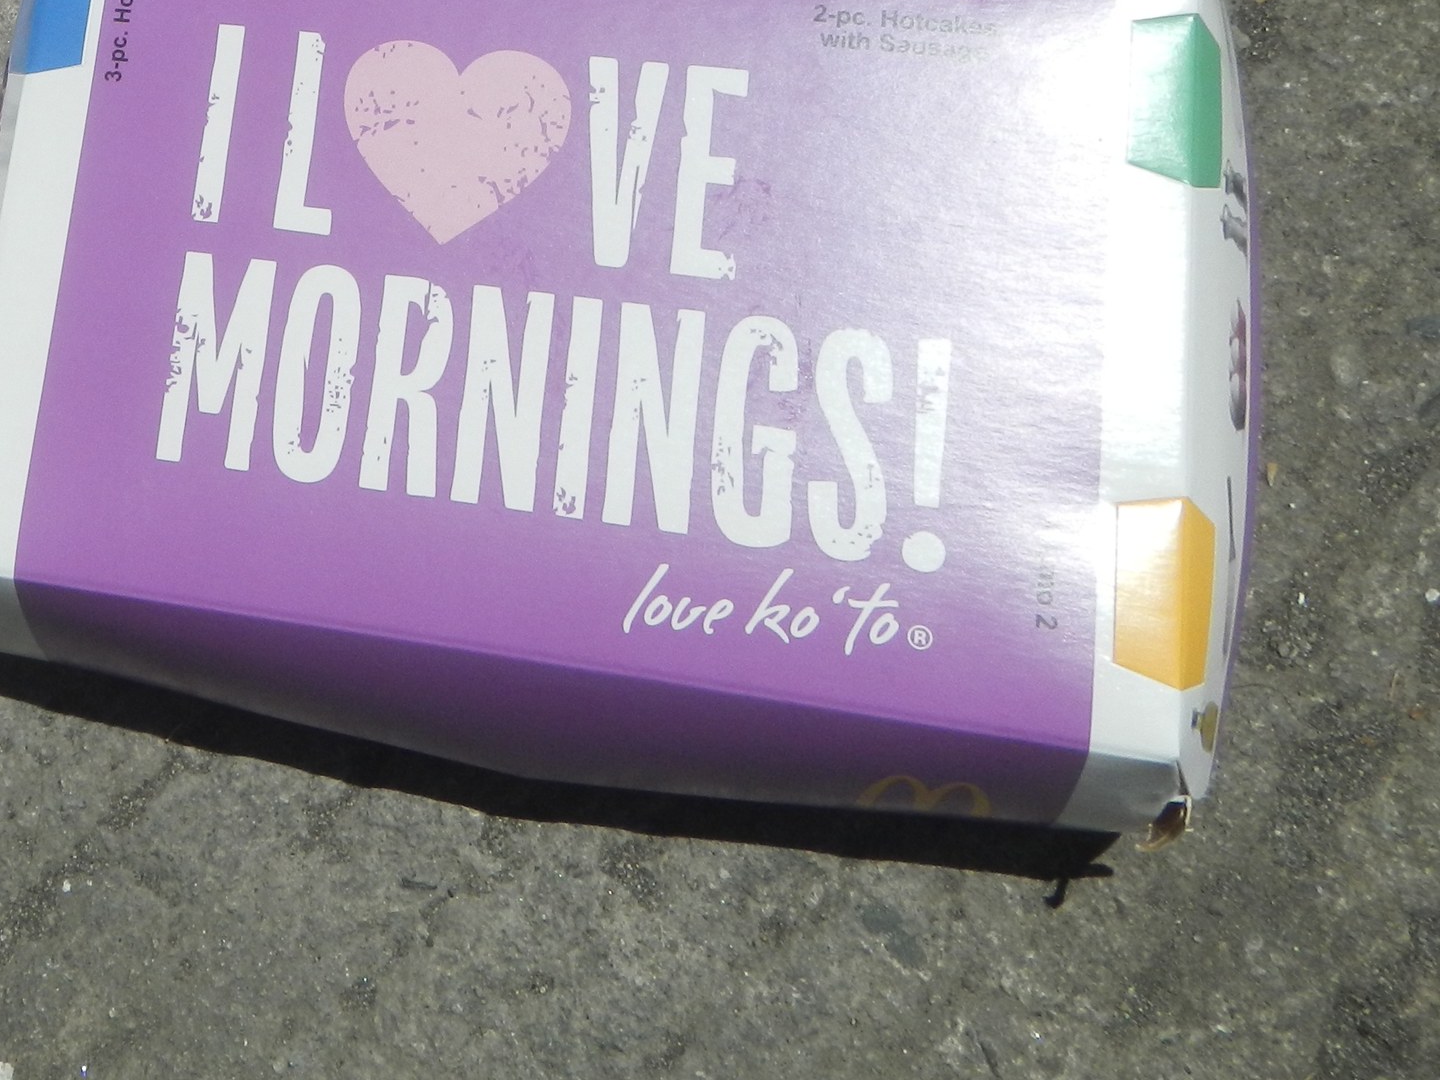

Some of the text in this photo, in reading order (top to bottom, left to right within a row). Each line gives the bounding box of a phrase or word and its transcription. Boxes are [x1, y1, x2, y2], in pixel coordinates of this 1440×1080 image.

[812, 4, 871, 27] 2-pc.
[820, 31, 870, 51] with
[104, 27, 128, 83] 3-pc.
[191, 24, 246, 224] I
[156, 251, 952, 573] MORNINGS!
[623, 564, 734, 635] love
[745, 569, 820, 644] ko
[1035, 614, 1058, 630] 2
